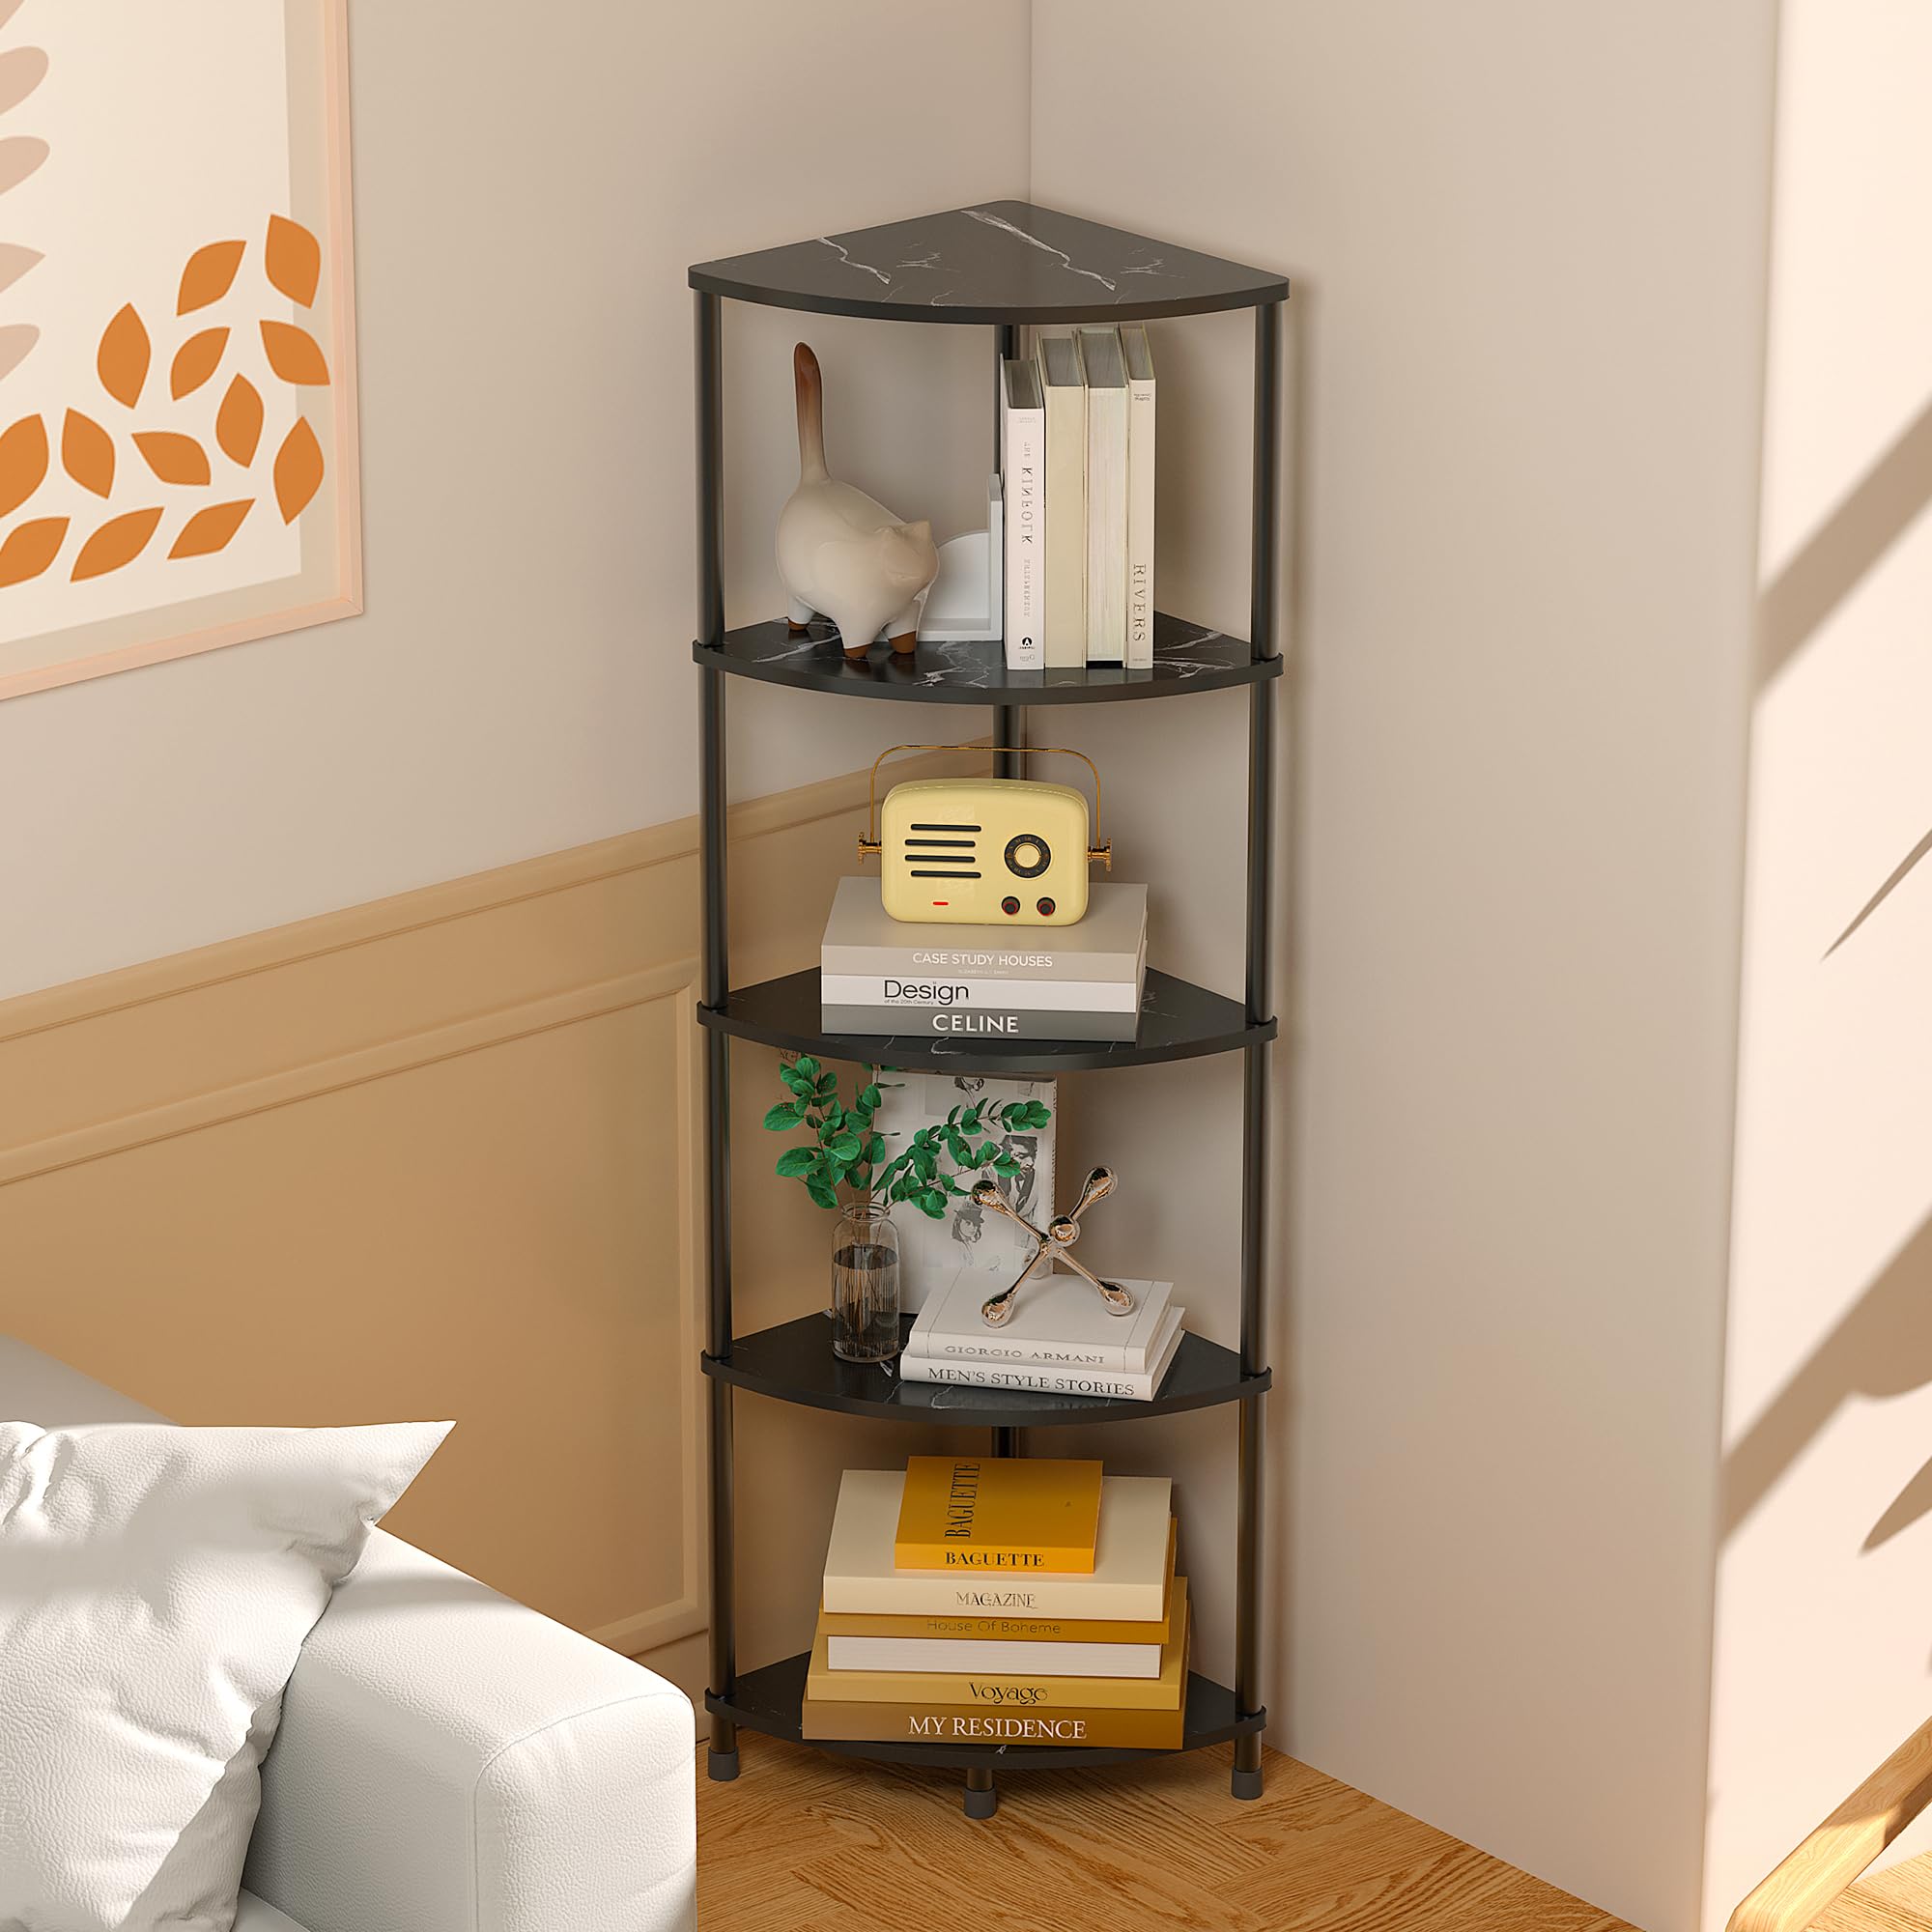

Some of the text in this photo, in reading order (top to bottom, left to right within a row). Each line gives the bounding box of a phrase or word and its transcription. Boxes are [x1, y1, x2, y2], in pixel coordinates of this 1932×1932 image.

[1133, 563, 1147, 641] RIVERS
[912, 952, 1053, 967] CASE STUDY HOUSES
[884, 980, 970, 1006] Design
[932, 1013, 1019, 1034] CELINE
[945, 1346, 1105, 1364] GIORGIO ARMANI
[927, 1368, 1135, 1396] MEN'S STYLE STORIES
[944, 1462, 981, 1539] BAGUETTE
[946, 1551, 1044, 1567] BAGUETTE
[956, 1591, 1038, 1609] MAGAZINE
[926, 1620, 1061, 1634] House Of Boheme
[969, 1681, 1048, 1705] Voyage
[908, 1716, 1088, 1740] MY RESIDENCE
